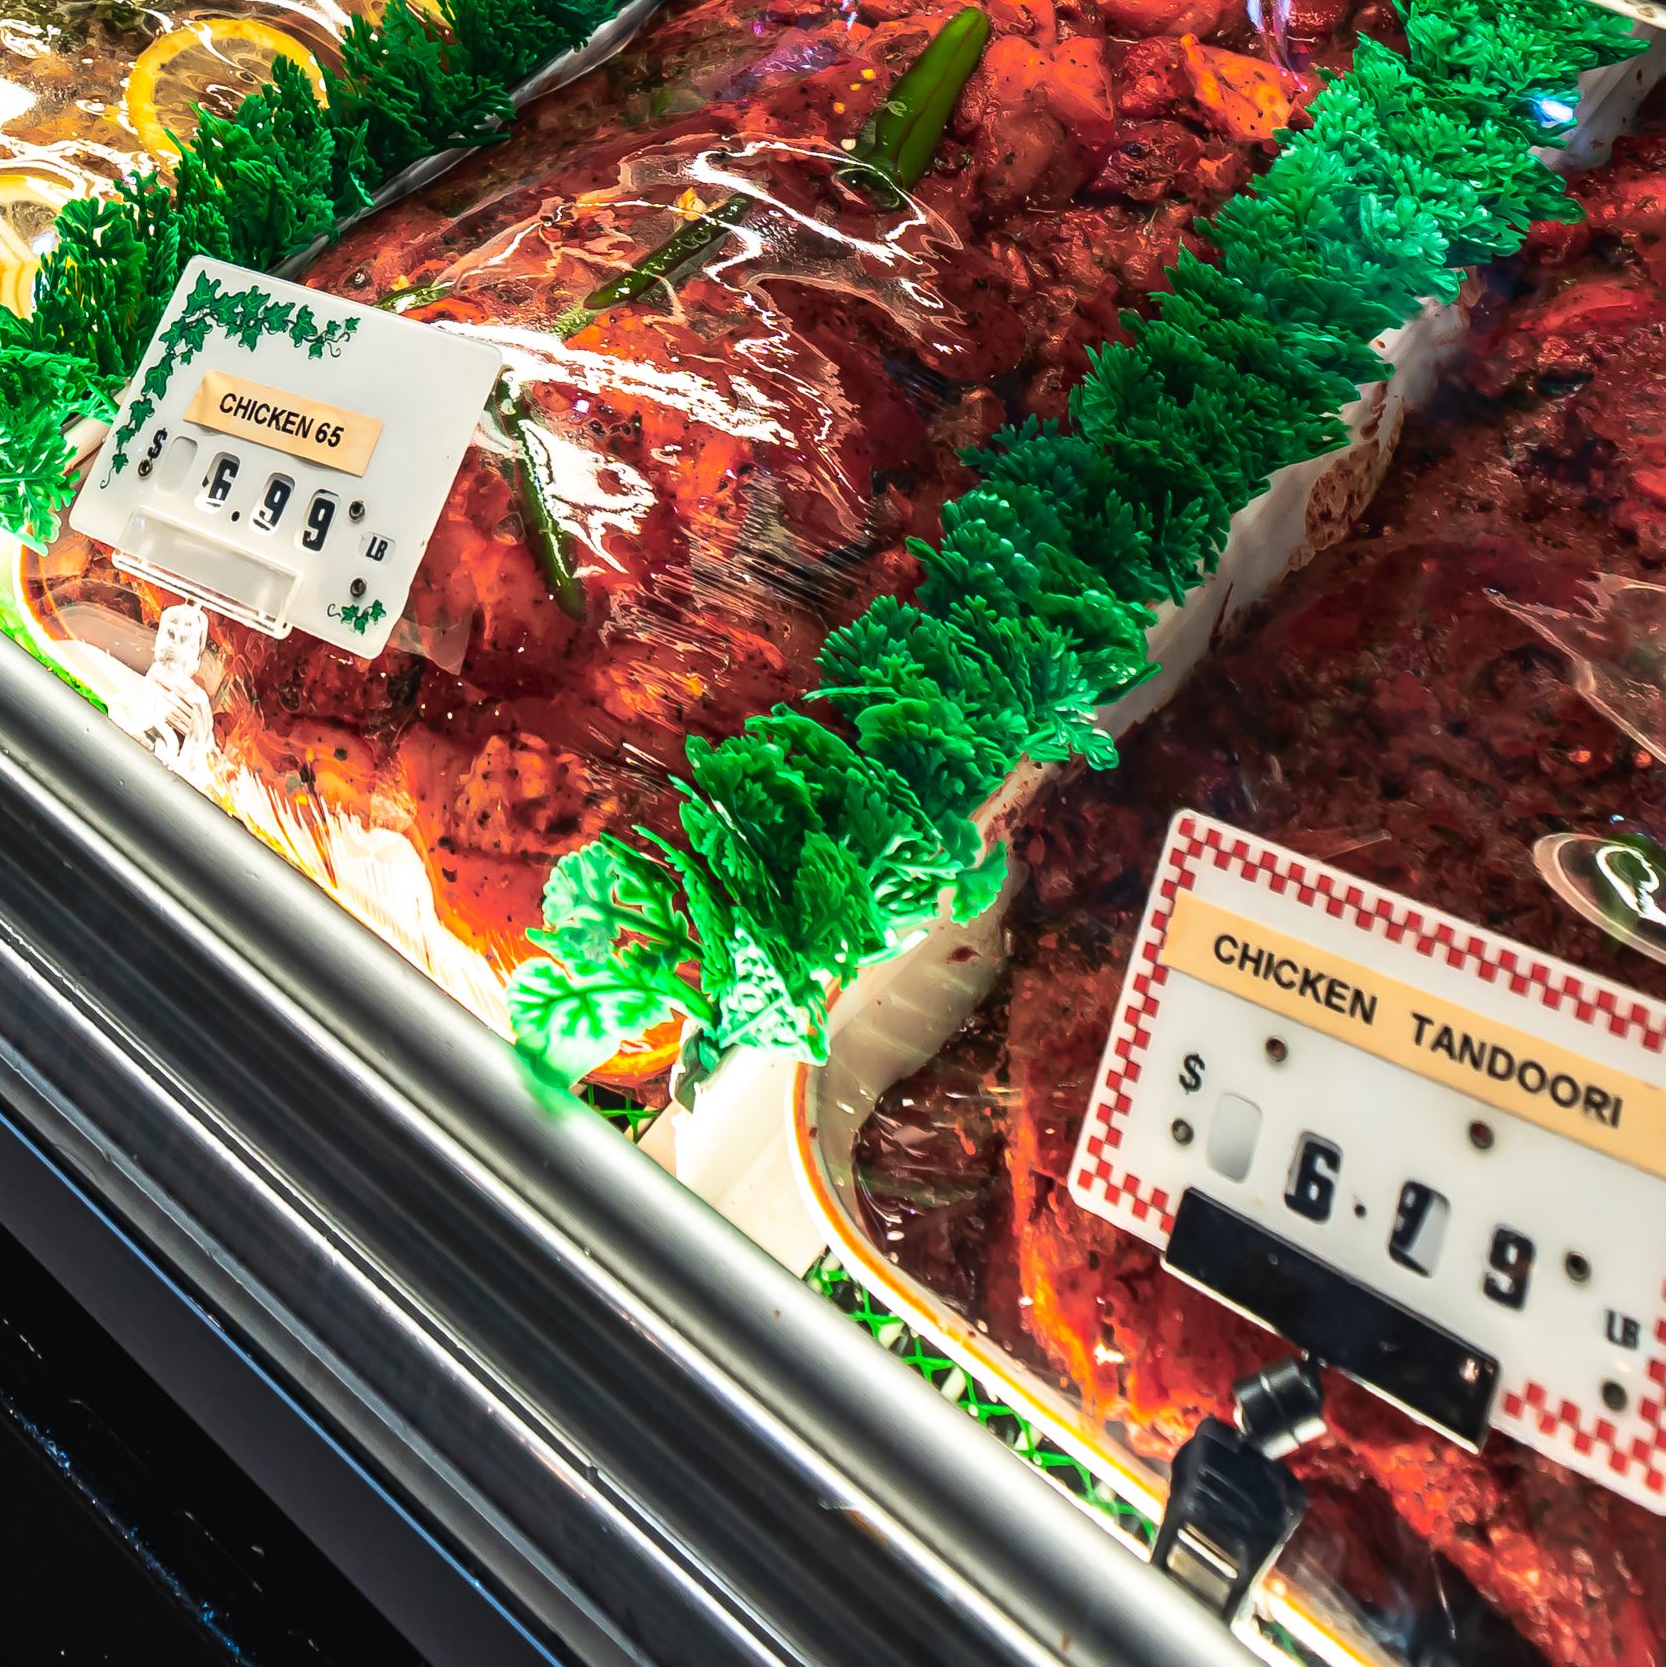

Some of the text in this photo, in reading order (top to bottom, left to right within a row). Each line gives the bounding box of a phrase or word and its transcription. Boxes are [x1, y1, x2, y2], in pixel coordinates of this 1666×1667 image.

[147, 427, 168, 460] $
[365, 536, 389, 562] LB
[219, 392, 345, 448] CHICKEN 65
[1214, 934, 1624, 1130] CHICKEN TANDOORI
[1178, 1053, 1206, 1094] $
[1605, 1308, 1641, 1352] LB
